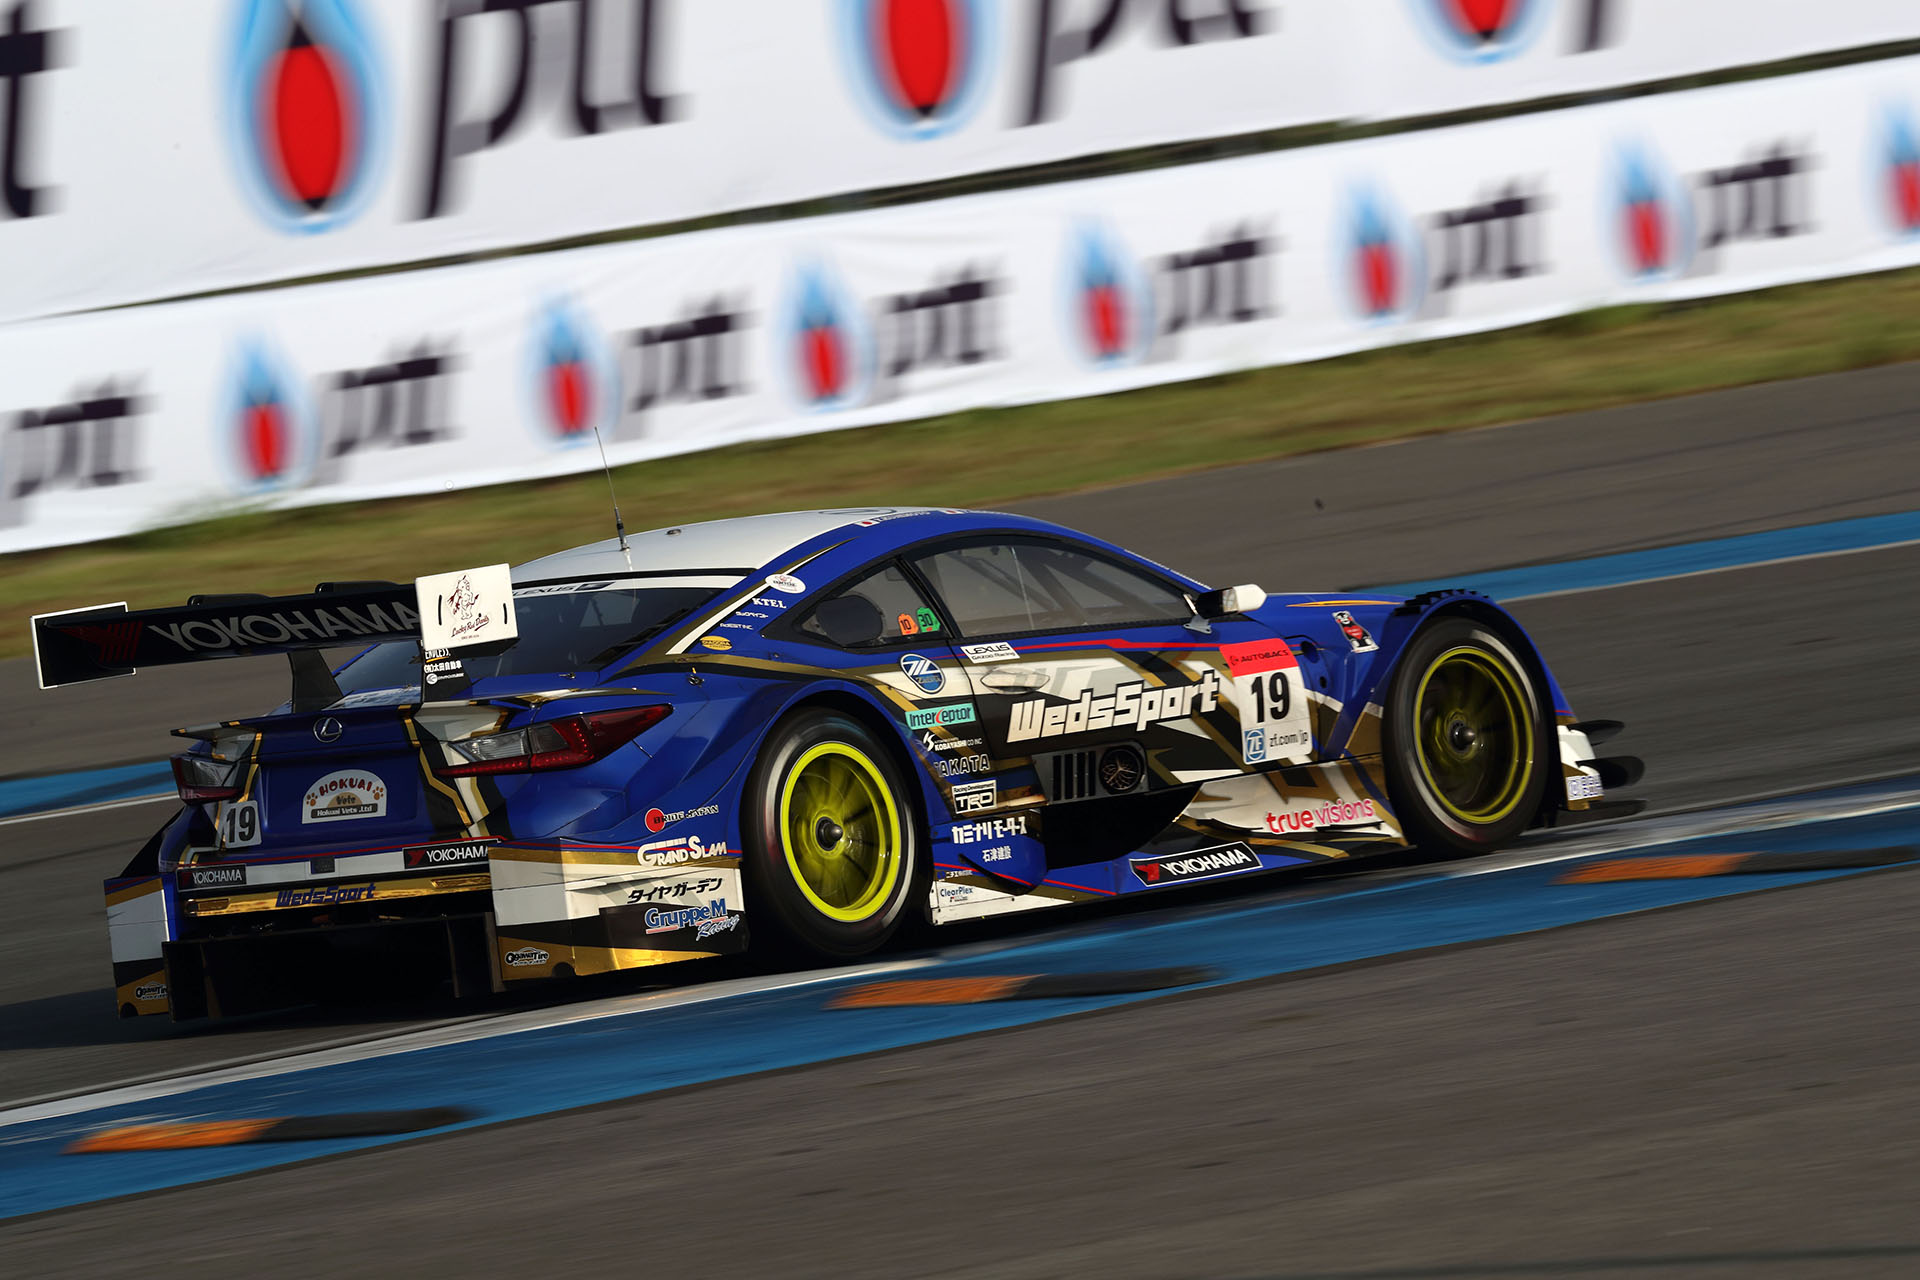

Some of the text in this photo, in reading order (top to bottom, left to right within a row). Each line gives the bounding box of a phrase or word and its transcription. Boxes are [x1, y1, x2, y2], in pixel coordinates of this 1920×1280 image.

[752, 597, 787, 608] KTEL
[148, 602, 420, 650] YOKOHAMA
[900, 619, 911, 630] 10
[919, 613, 933, 626] 30
[965, 644, 1010, 655] LEXUS
[1241, 650, 1289, 662] AUTOBACS
[1251, 671, 1290, 723] 19
[1007, 671, 1219, 743] WedsSport
[935, 740, 967, 751] KOBAYASHI
[1247, 737, 1265, 755] ZF
[319, 778, 373, 796] HOKUAI
[955, 792, 993, 810] TRD
[653, 805, 719, 824] BRIDE JAPAN
[1266, 799, 1374, 834] true visions
[226, 805, 256, 843] 19
[1160, 849, 1252, 876] YOKOHAMA
[192, 868, 242, 885] YOKOHAMA
[275, 883, 376, 907] WedsSport
[627, 877, 723, 904] タイヤガーデン
[940, 886, 973, 897] ClearPlex
